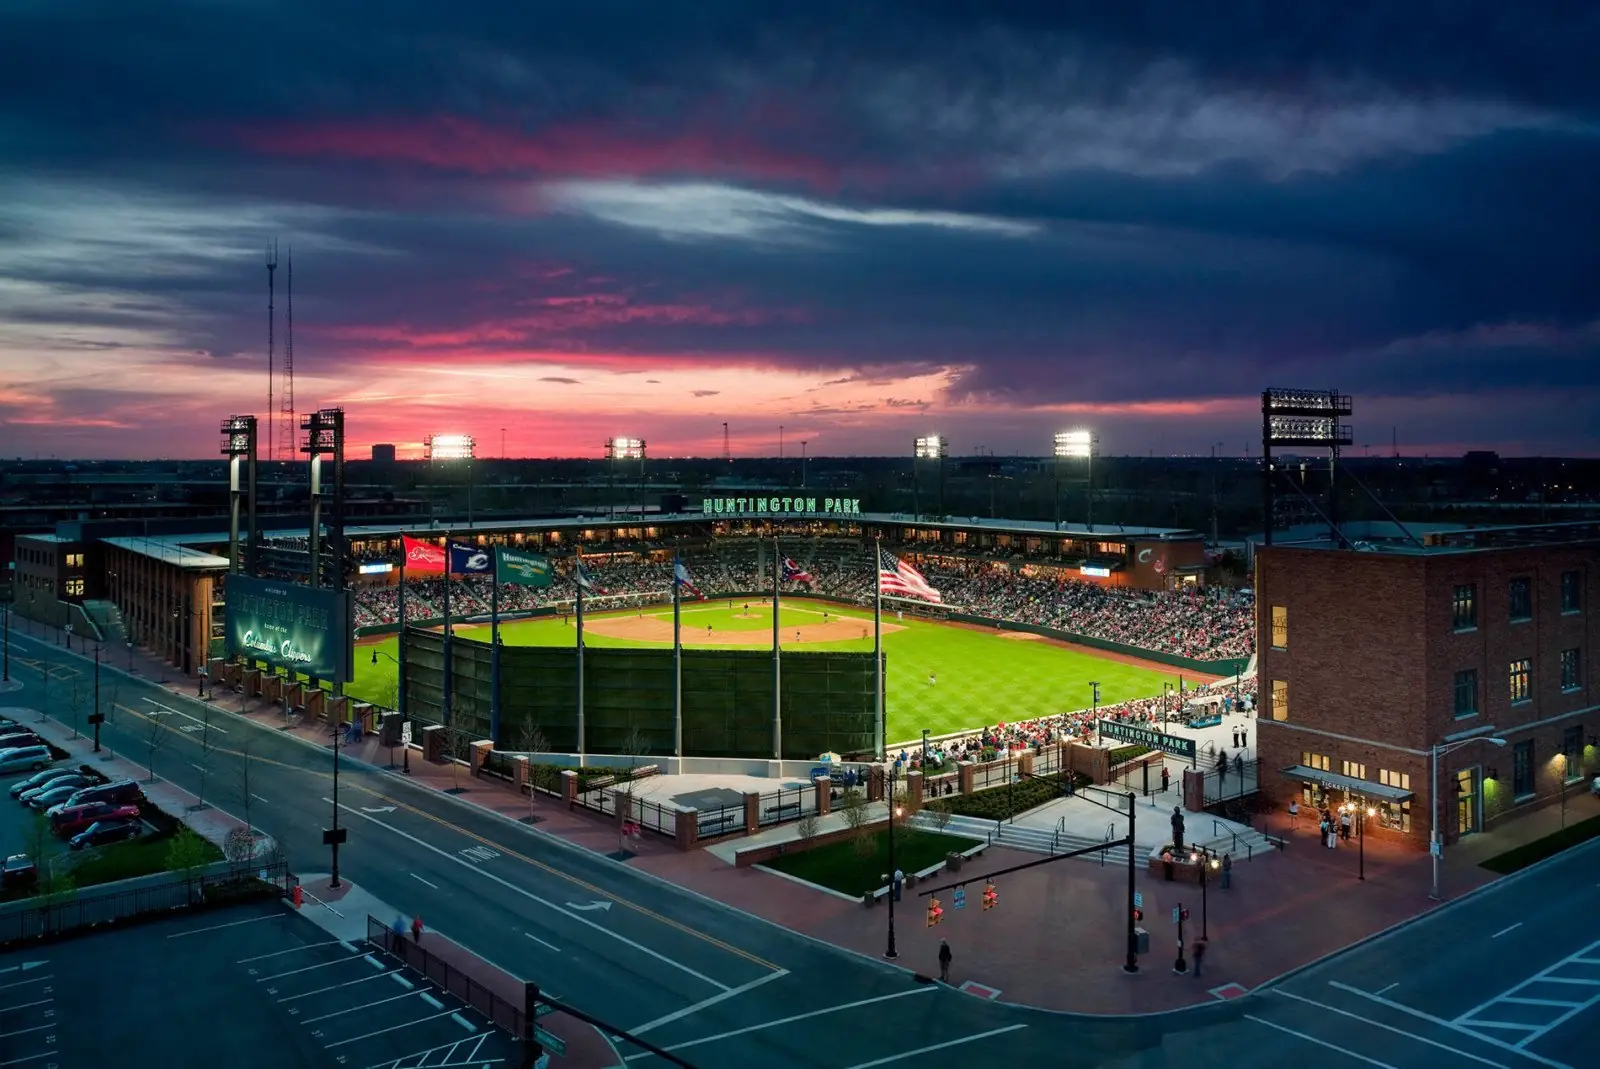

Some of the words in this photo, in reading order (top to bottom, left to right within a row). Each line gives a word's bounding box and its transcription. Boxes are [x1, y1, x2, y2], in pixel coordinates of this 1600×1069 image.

[703, 498, 816, 513] HUNTINGTON
[824, 498, 861, 514] PARK
[243, 630, 277, 653] Columbus
[281, 640, 312, 662] Clippers
[1102, 722, 1159, 744] HUNTINGTON
[1163, 736, 1188, 751] PARK
[1322, 781, 1350, 791] TICKETS
